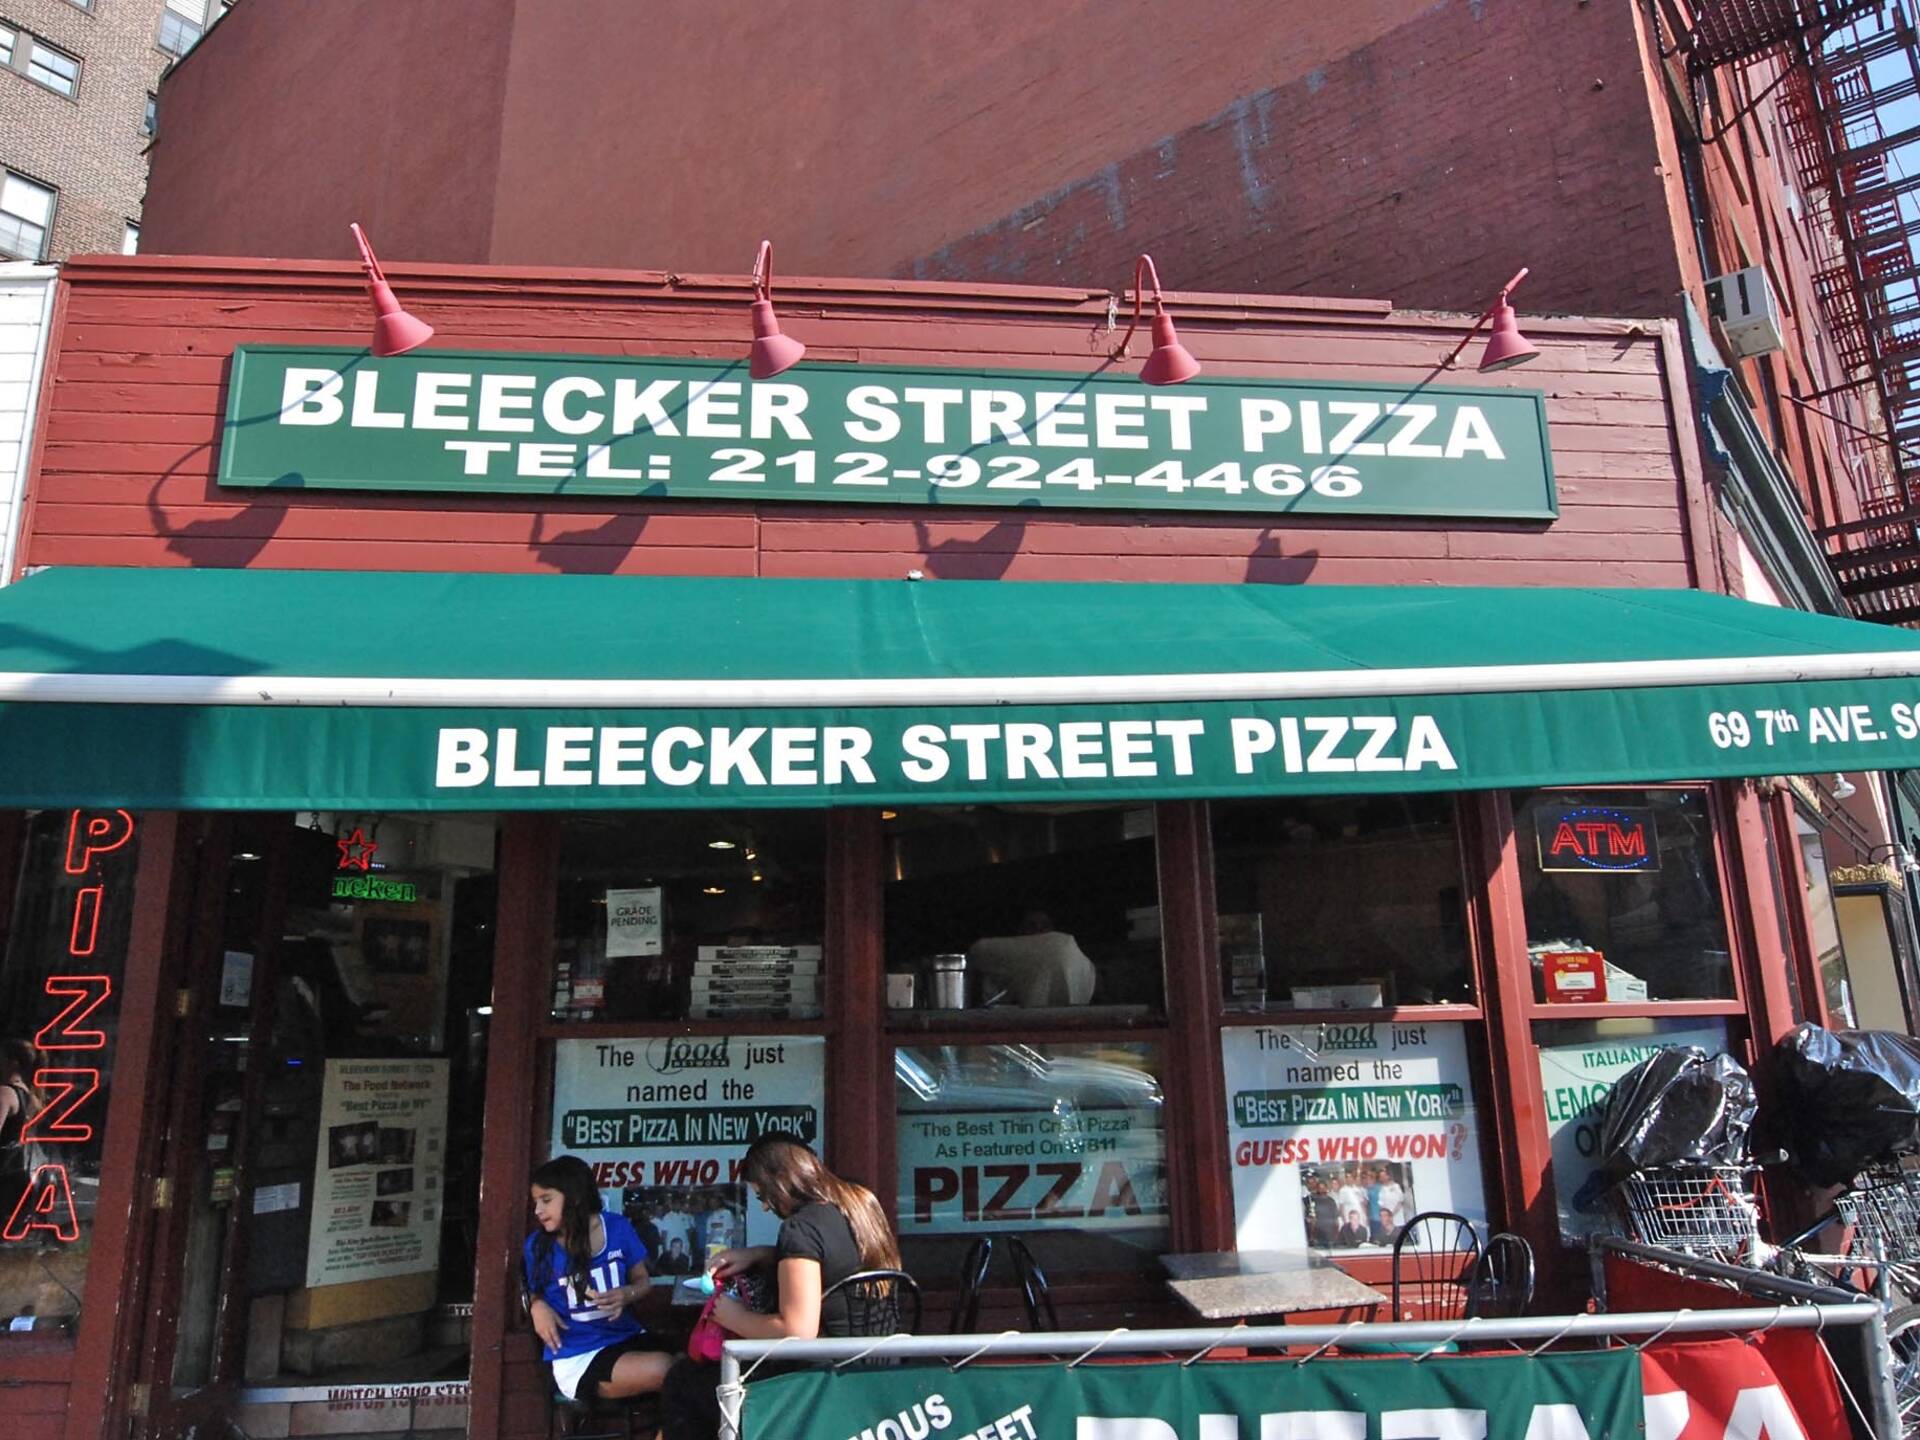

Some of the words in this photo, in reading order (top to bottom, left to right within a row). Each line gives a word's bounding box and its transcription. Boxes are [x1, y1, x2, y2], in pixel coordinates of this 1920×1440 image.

[279, 367, 812, 441] BLEECKER
[844, 385, 1208, 450] STREET
[1239, 397, 1507, 461] PIZZA
[444, 440, 672, 480] TEL:
[708, 448, 1364, 498] 212-924-4466
[1708, 711, 1751, 748] 69
[1755, 709, 1800, 746] 7th
[1809, 705, 1888, 744] AVE.
[435, 726, 877, 788] BLEECKER
[901, 719, 1205, 783] STREET
[1230, 715, 1458, 774] PIZZA
[1551, 823, 1647, 856] ATM
[610, 914, 658, 927] PENDING
[615, 905, 652, 917] GRADE
[3, 809, 134, 1241] PIZZA
[1255, 1029, 1291, 1050] The
[1392, 1025, 1427, 1051] just
[596, 1044, 635, 1067] The
[657, 1036, 730, 1072] food
[744, 1043, 785, 1070] just
[1583, 1046, 1643, 1068] ITALIAN
[1287, 1059, 1360, 1083] named
[1373, 1058, 1403, 1080] the
[626, 1078, 707, 1102] named
[722, 1078, 754, 1100] the
[1236, 1096, 1287, 1123] "BEST
[1292, 1094, 1341, 1121] PIZZA
[1342, 1092, 1359, 1120] IN
[1363, 1091, 1403, 1120] NEW
[566, 1114, 623, 1144] "BEST
[629, 1113, 678, 1143] PIZZA
[685, 1112, 702, 1141] IN
[708, 1112, 749, 1141] NEW
[912, 1122, 951, 1138] "The
[956, 1120, 995, 1136] Best
[1000, 1119, 1034, 1135] Thin
[1039, 1117, 1083, 1134] Crt
[1088, 1115, 1136, 1132] Pizza"
[935, 1142, 957, 1158] As
[963, 1139, 1035, 1157] Featured
[1040, 1139, 1064, 1155] On
[1235, 1138, 1310, 1167] GUESS
[1318, 1136, 1378, 1161] WHO
[1385, 1123, 1468, 1162] WON?
[654, 1158, 720, 1186] WHO
[914, 1161, 1142, 1224] PIZZA
